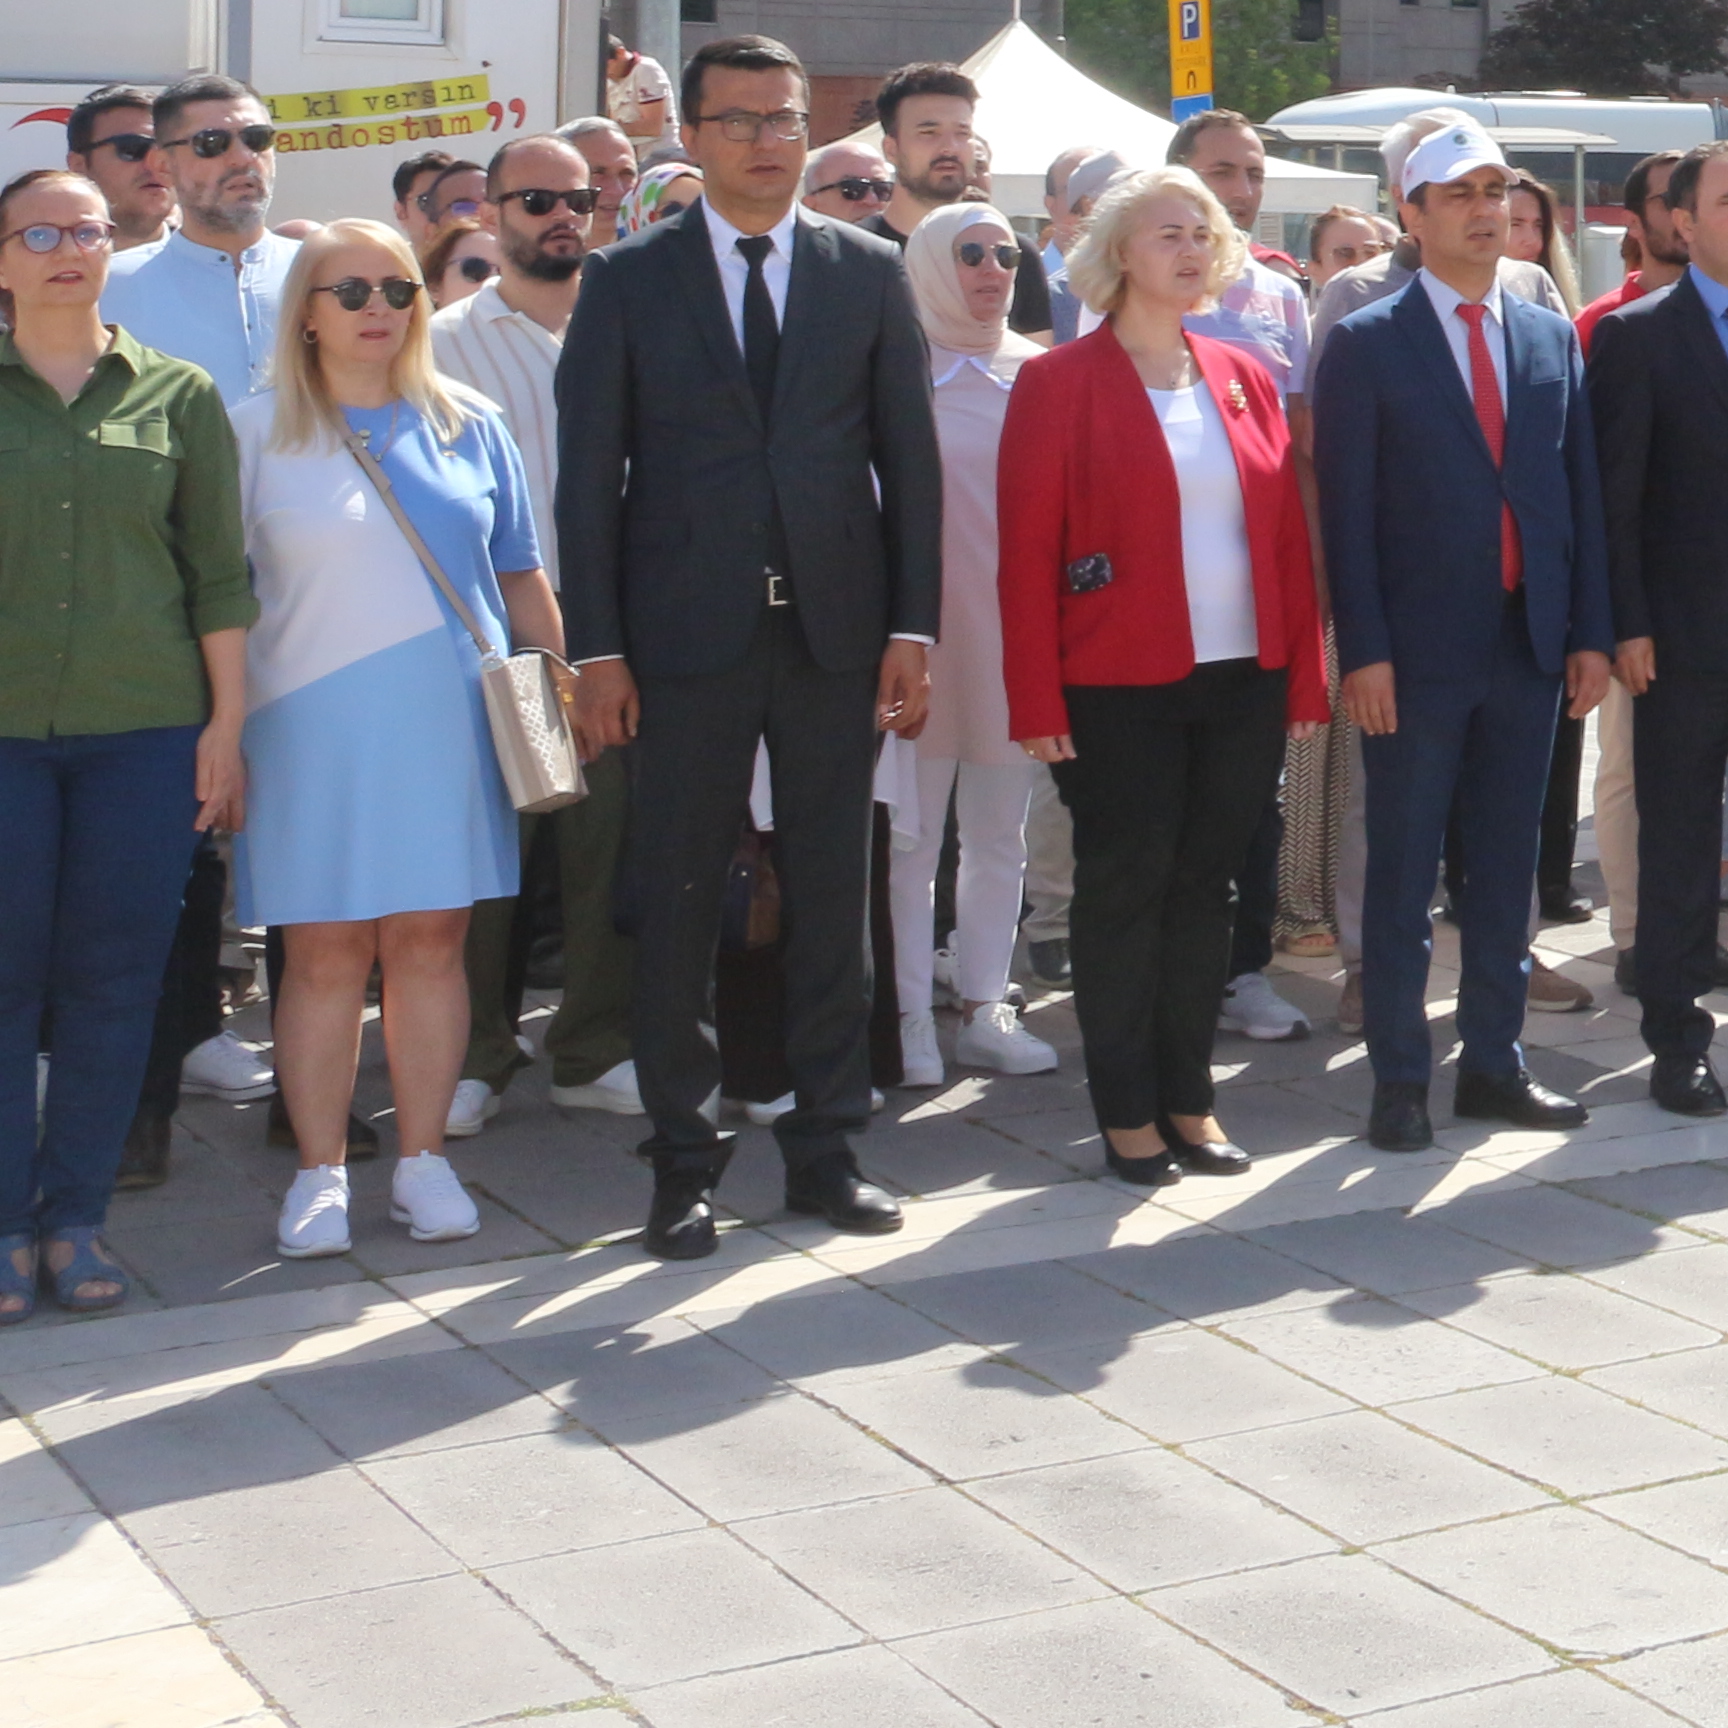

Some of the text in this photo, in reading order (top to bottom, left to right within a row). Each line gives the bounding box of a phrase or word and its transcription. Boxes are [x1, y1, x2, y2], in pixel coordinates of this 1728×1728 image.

[1183, 3, 1197, 38] P
[303, 94, 342, 118] ki
[363, 82, 477, 112] varsın
[275, 114, 473, 153] andostum
